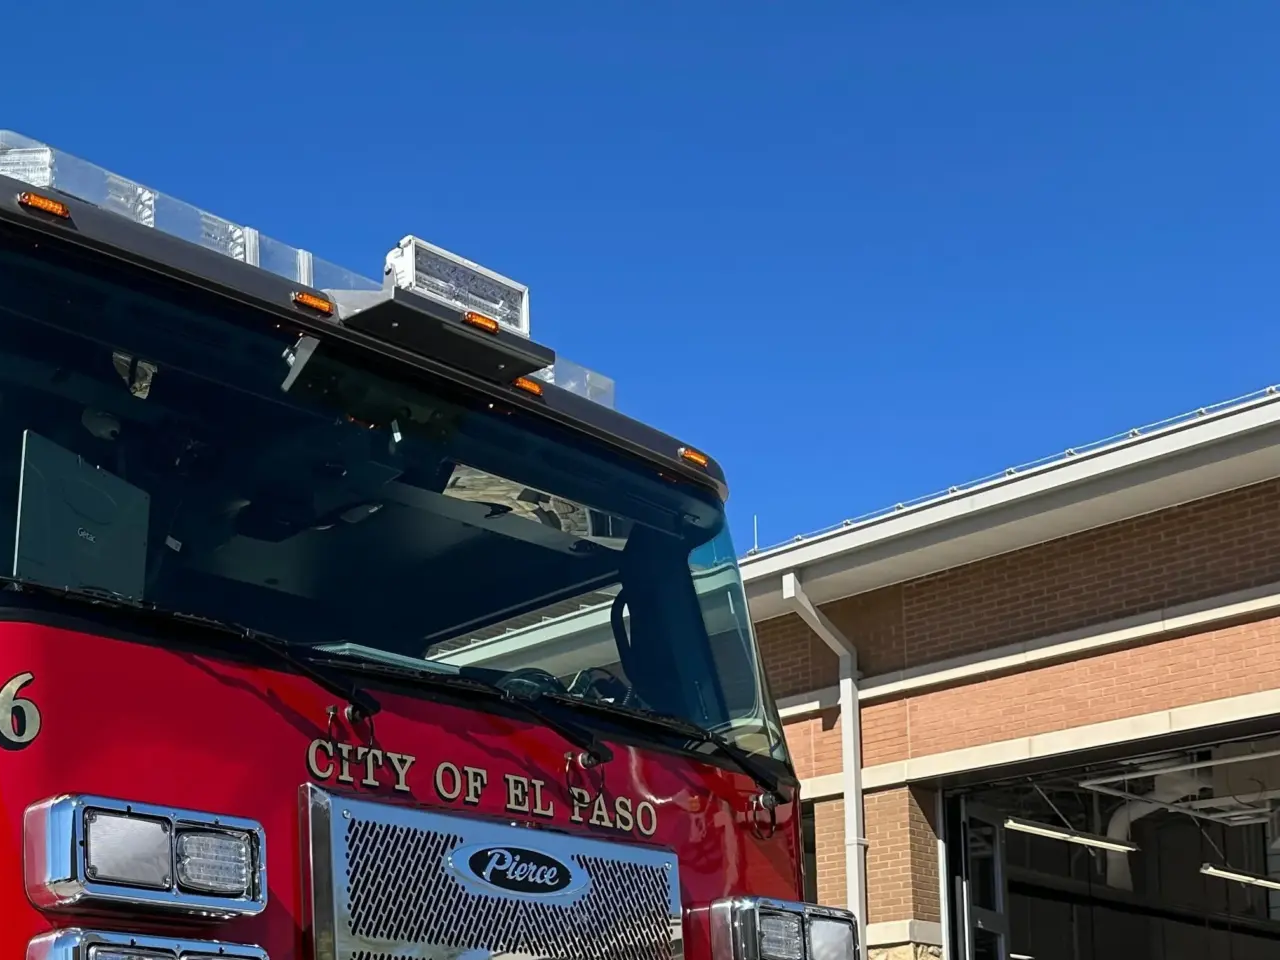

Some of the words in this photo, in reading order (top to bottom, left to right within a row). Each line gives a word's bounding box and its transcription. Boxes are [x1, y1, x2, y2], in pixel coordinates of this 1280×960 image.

[307, 739, 416, 793] CITY
[434, 761, 488, 805] OF
[504, 773, 555, 819] EL
[570, 786, 658, 837] PASO
[482, 848, 560, 887] Pierce
